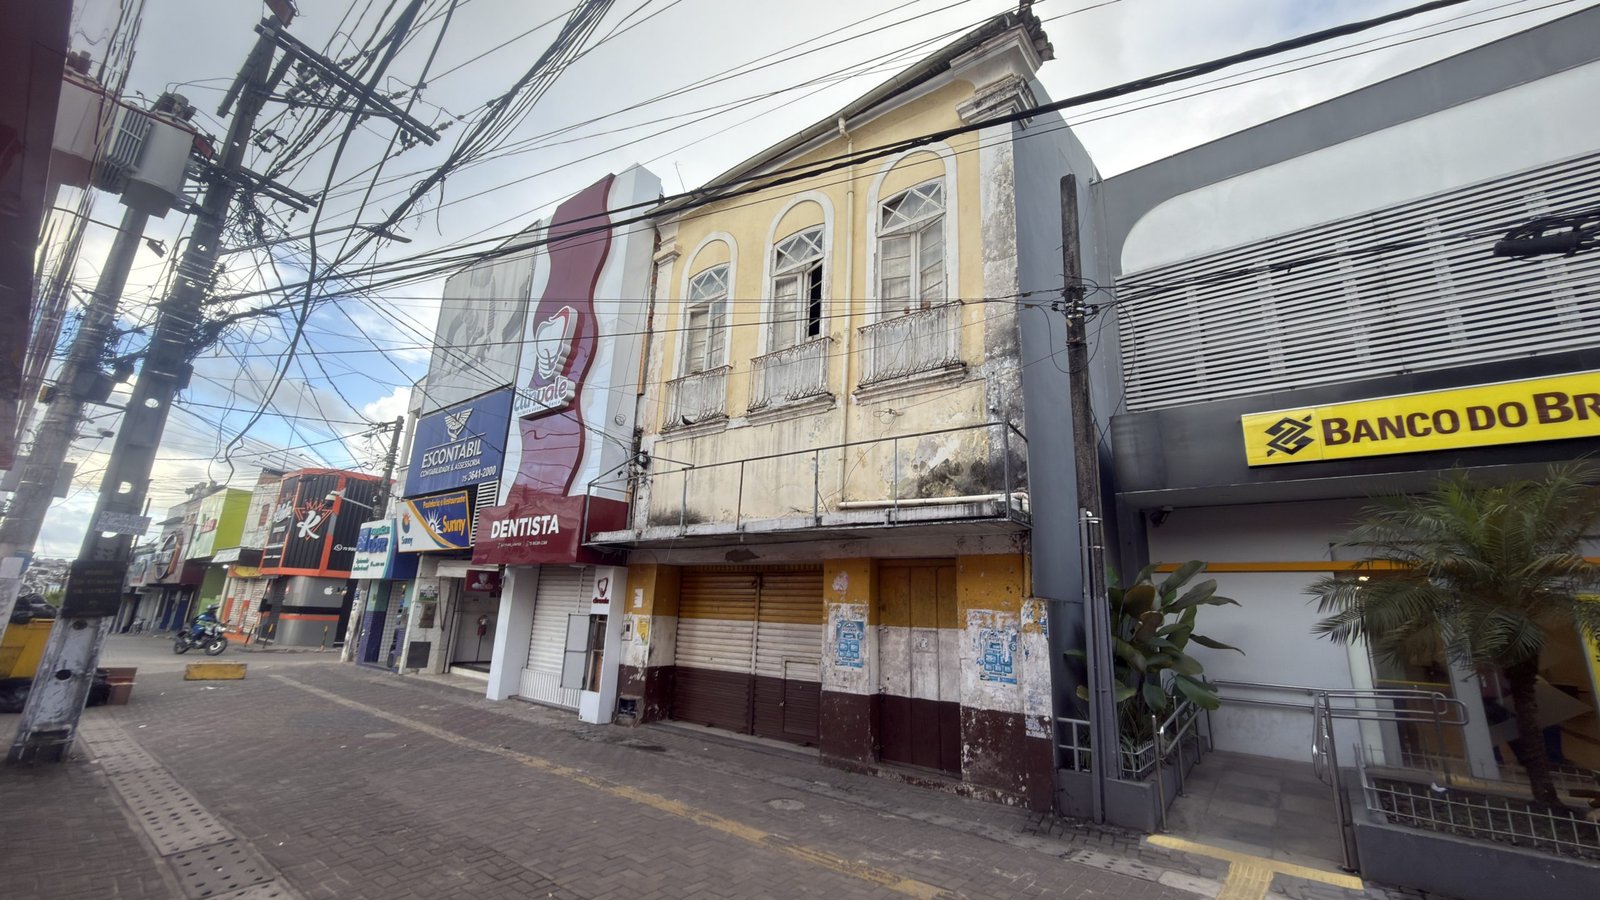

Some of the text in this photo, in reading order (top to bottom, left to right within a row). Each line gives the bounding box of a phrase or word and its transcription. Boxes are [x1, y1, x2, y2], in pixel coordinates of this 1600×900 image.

[1320, 408, 1460, 447] BANCO
[1465, 401, 1529, 432] DO
[421, 439, 482, 470] ESCONTABIL
[454, 459, 481, 470] ASSESSORIA
[467, 465, 497, 481] 3641-2000
[442, 515, 466, 536] Sunny
[490, 513, 559, 539] DENTISTA
[401, 536, 413, 546] Sunny
